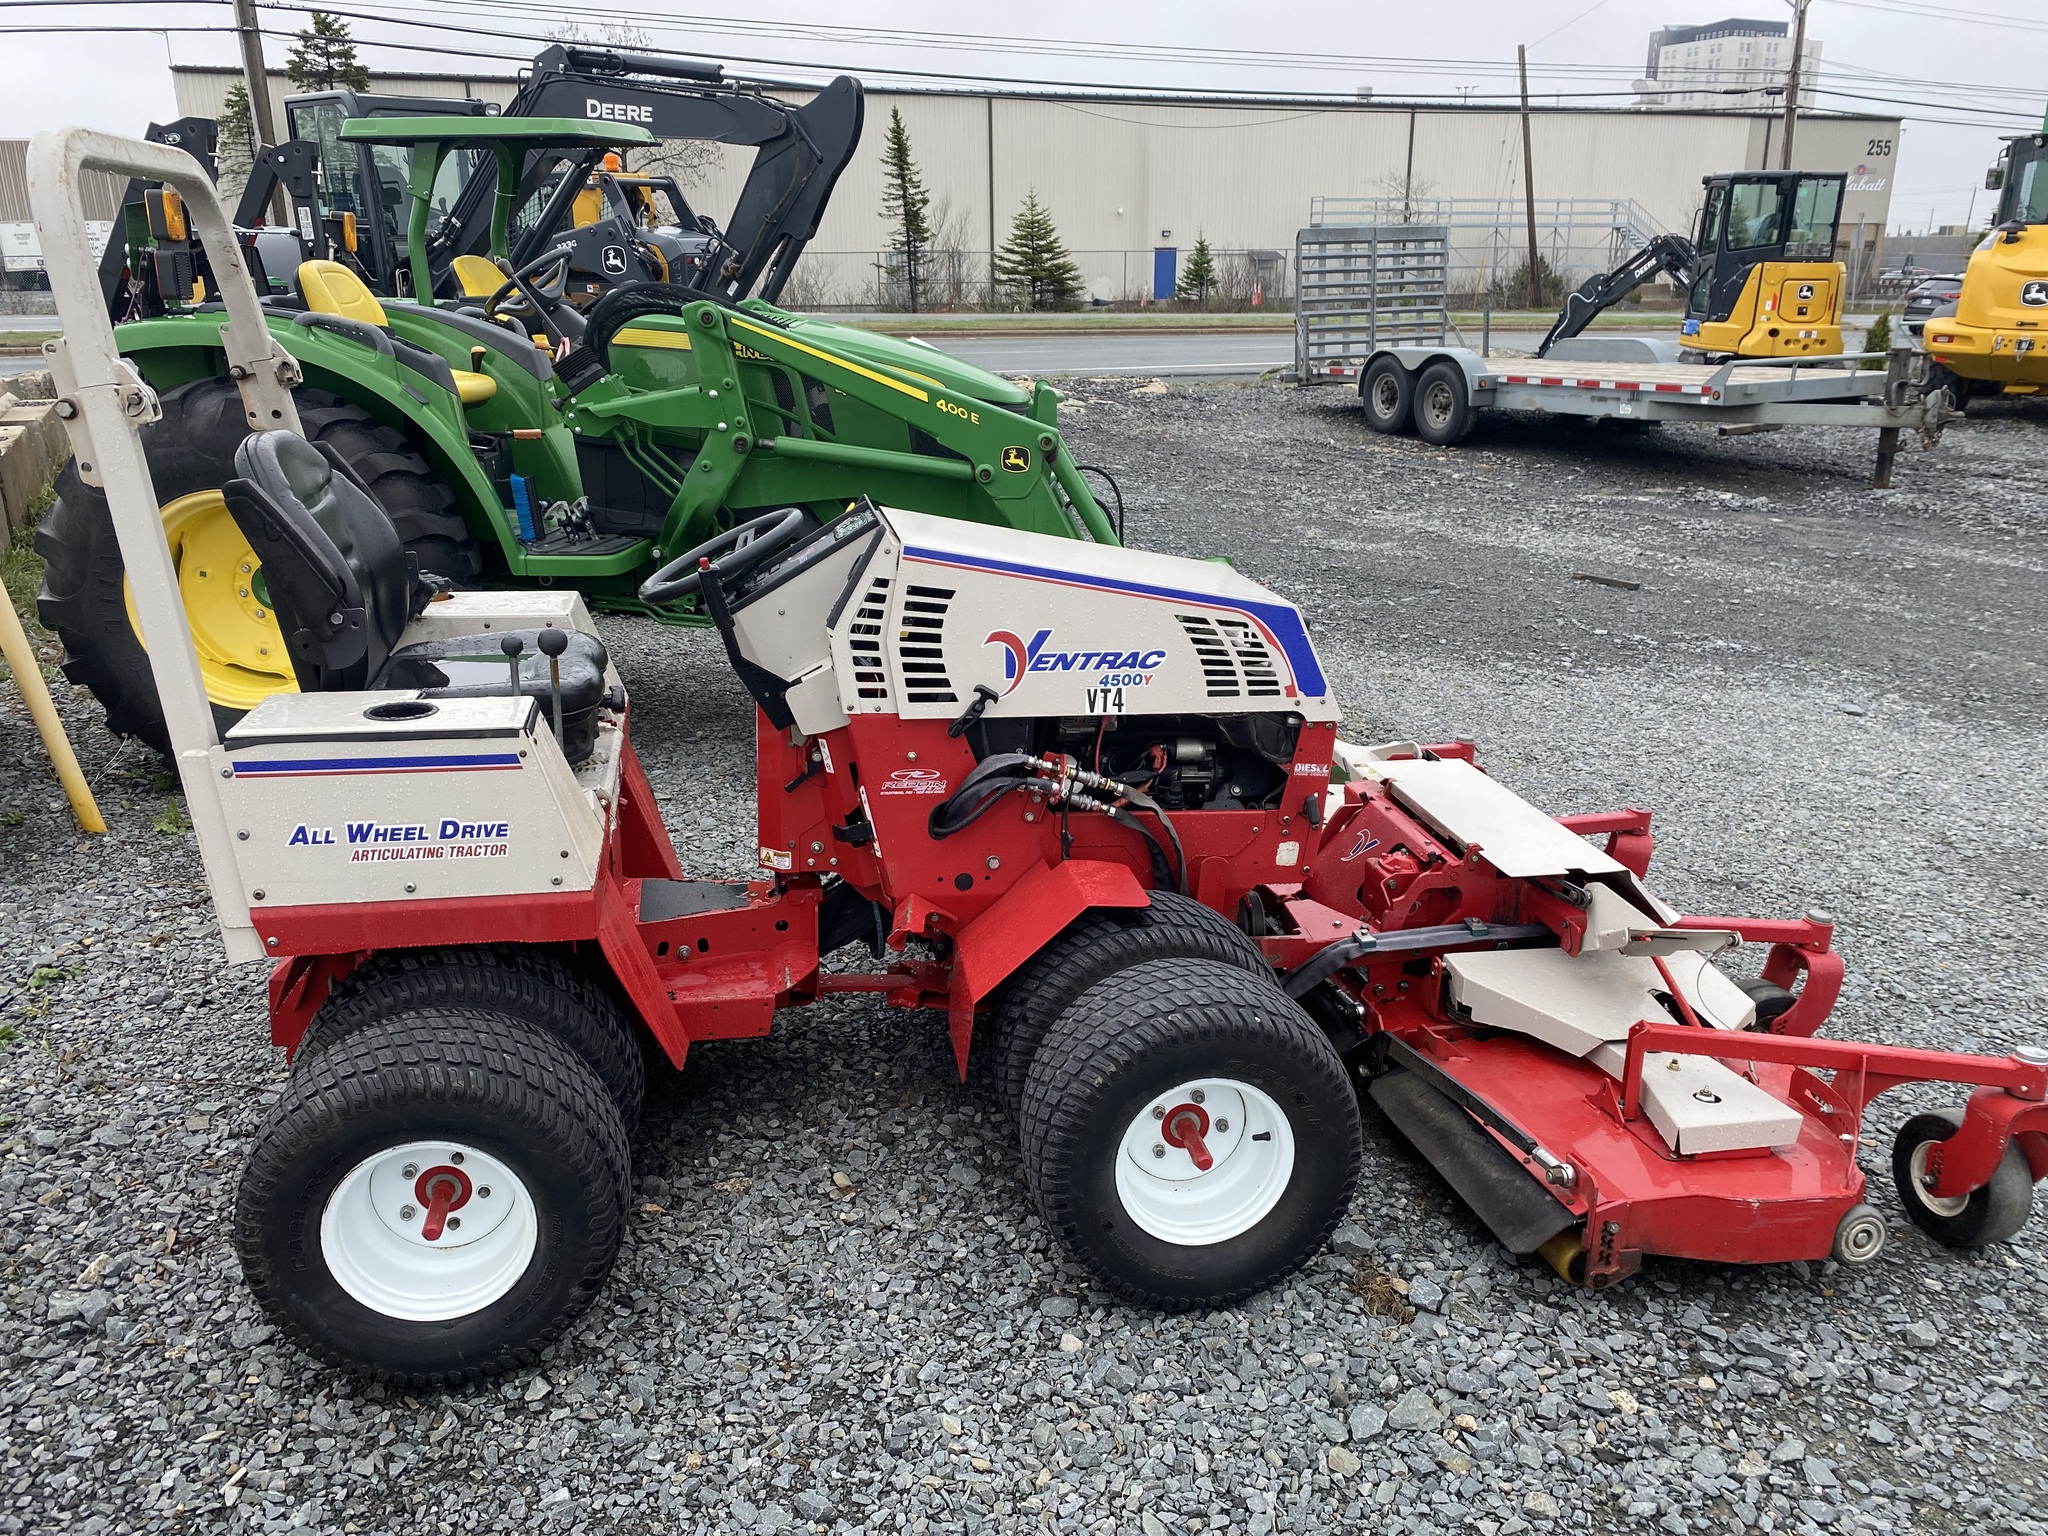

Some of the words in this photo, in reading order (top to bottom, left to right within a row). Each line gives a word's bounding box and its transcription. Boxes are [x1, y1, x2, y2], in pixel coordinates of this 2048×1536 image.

[586, 98, 653, 122] DEERE
[1866, 139, 1892, 156] 255
[1634, 256, 1657, 279] DEERE
[936, 399, 968, 419] 400
[971, 412, 980, 425] E
[983, 630, 1166, 697] VENTRAC
[1099, 673, 1154, 687] 4500Y
[1087, 687, 1125, 713] VT4
[288, 826, 335, 846] ALL
[346, 823, 429, 844] WHEEL
[438, 820, 509, 840] DRIVE
[351, 846, 444, 862] ARTICULATING
[449, 844, 508, 858] TRACTOR
